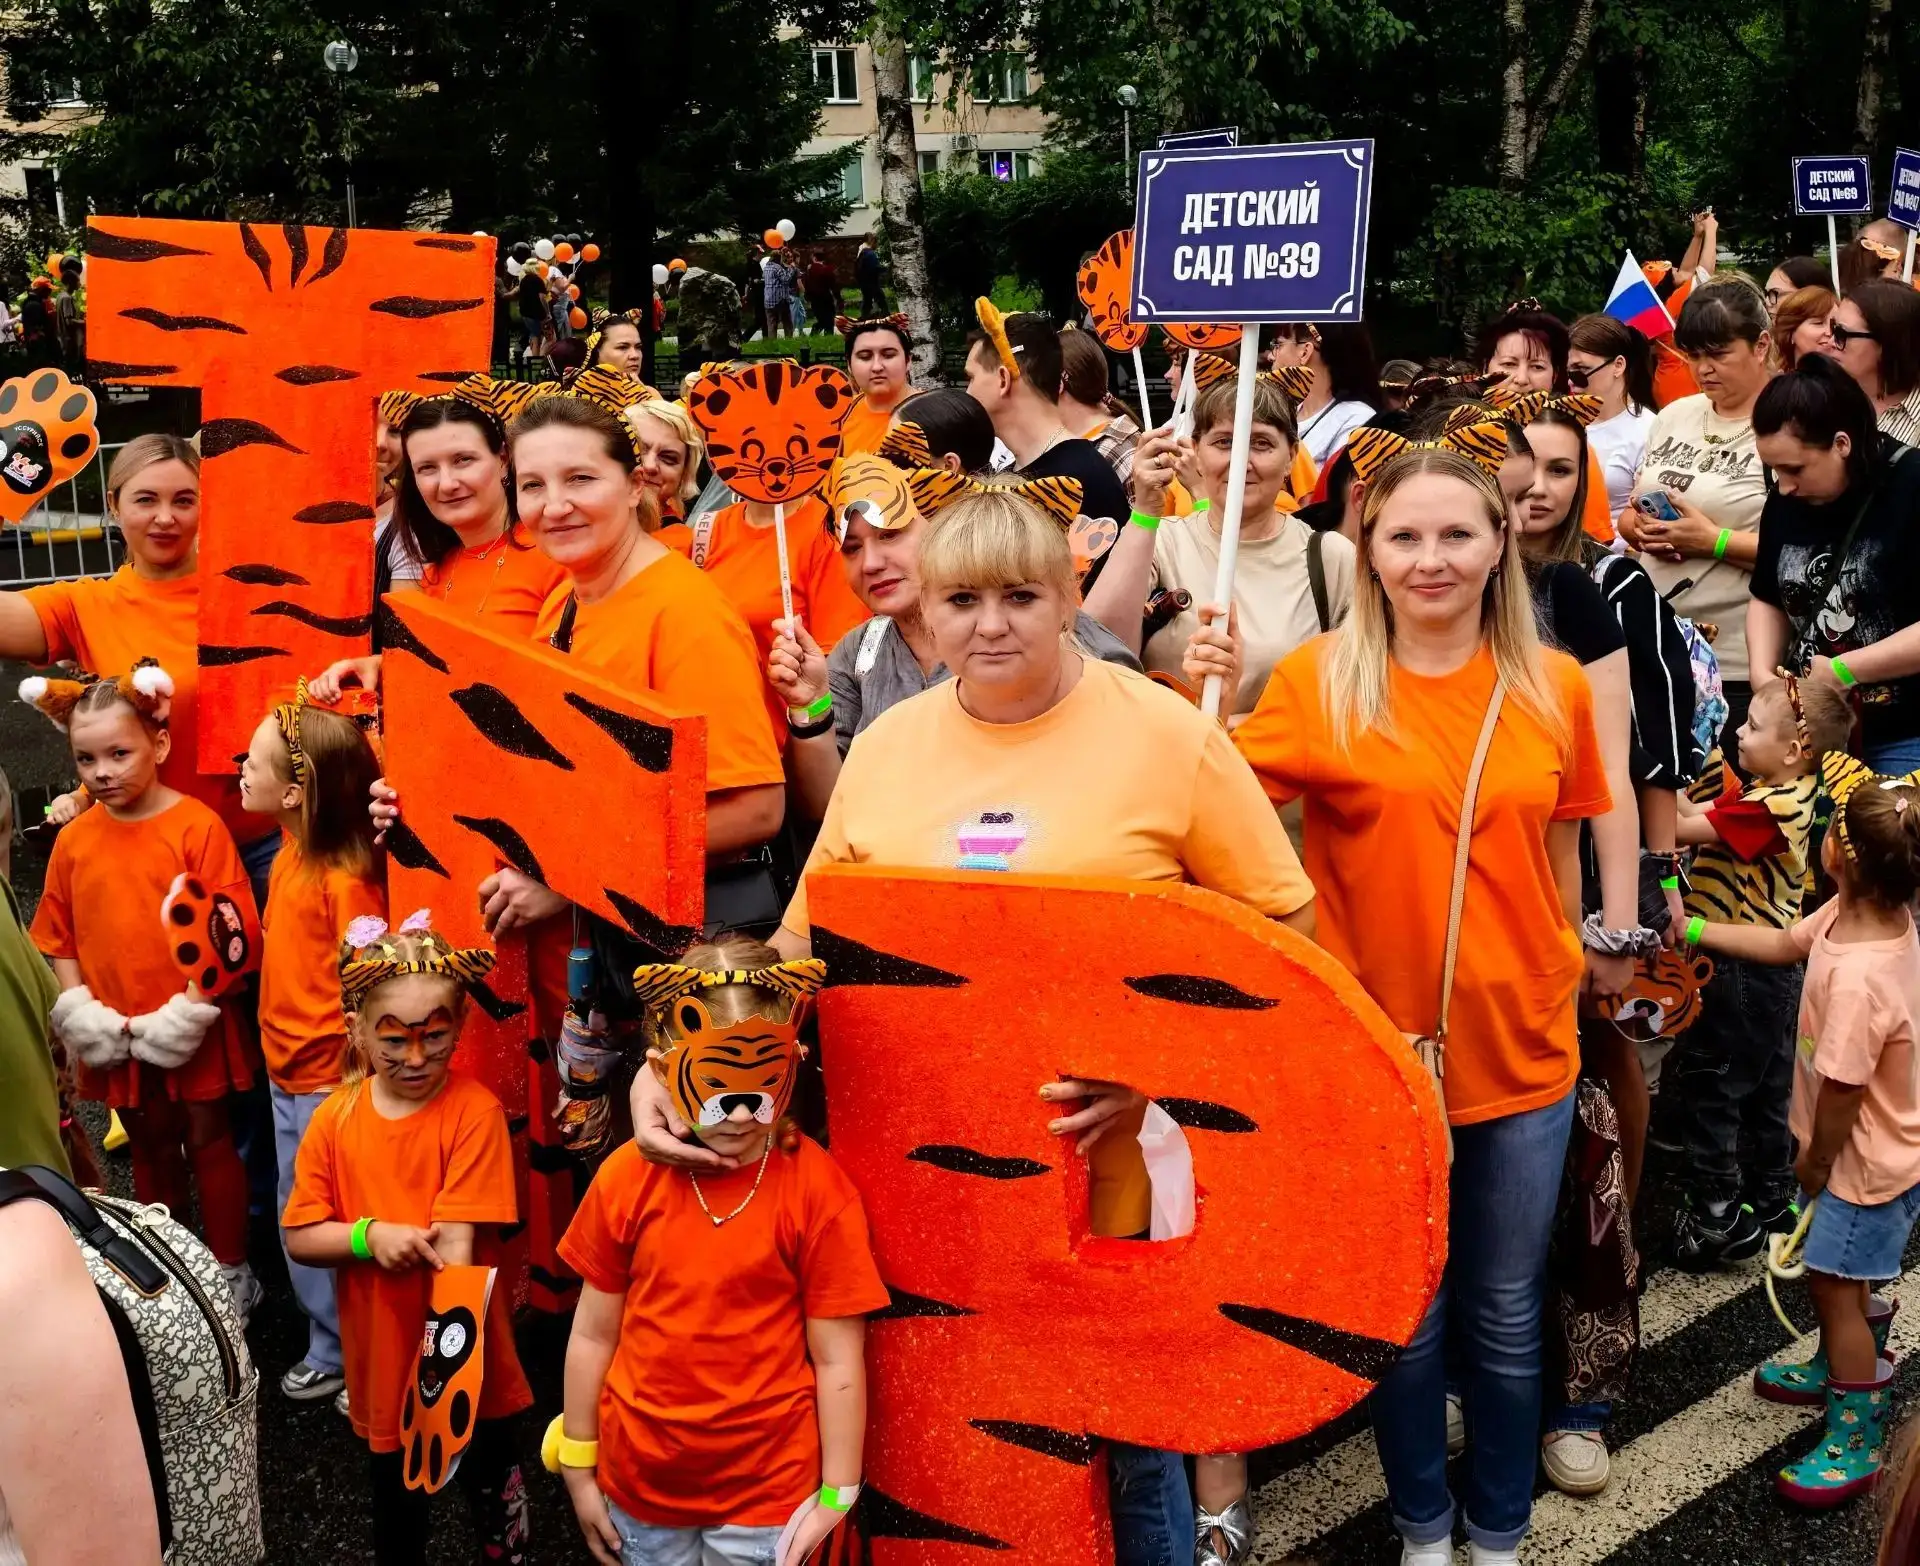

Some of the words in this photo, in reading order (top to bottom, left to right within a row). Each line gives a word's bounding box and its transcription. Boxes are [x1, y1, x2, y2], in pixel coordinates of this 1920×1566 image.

[1809, 168, 1855, 185] ДЕТСКИЙ
[1180, 180, 1321, 235] ДЕТСКИЙ
[1809, 188, 1830, 202] САД
[1832, 187, 1858, 200] №69
[1173, 244, 1235, 287] САД
[1243, 241, 1321, 280] №39
